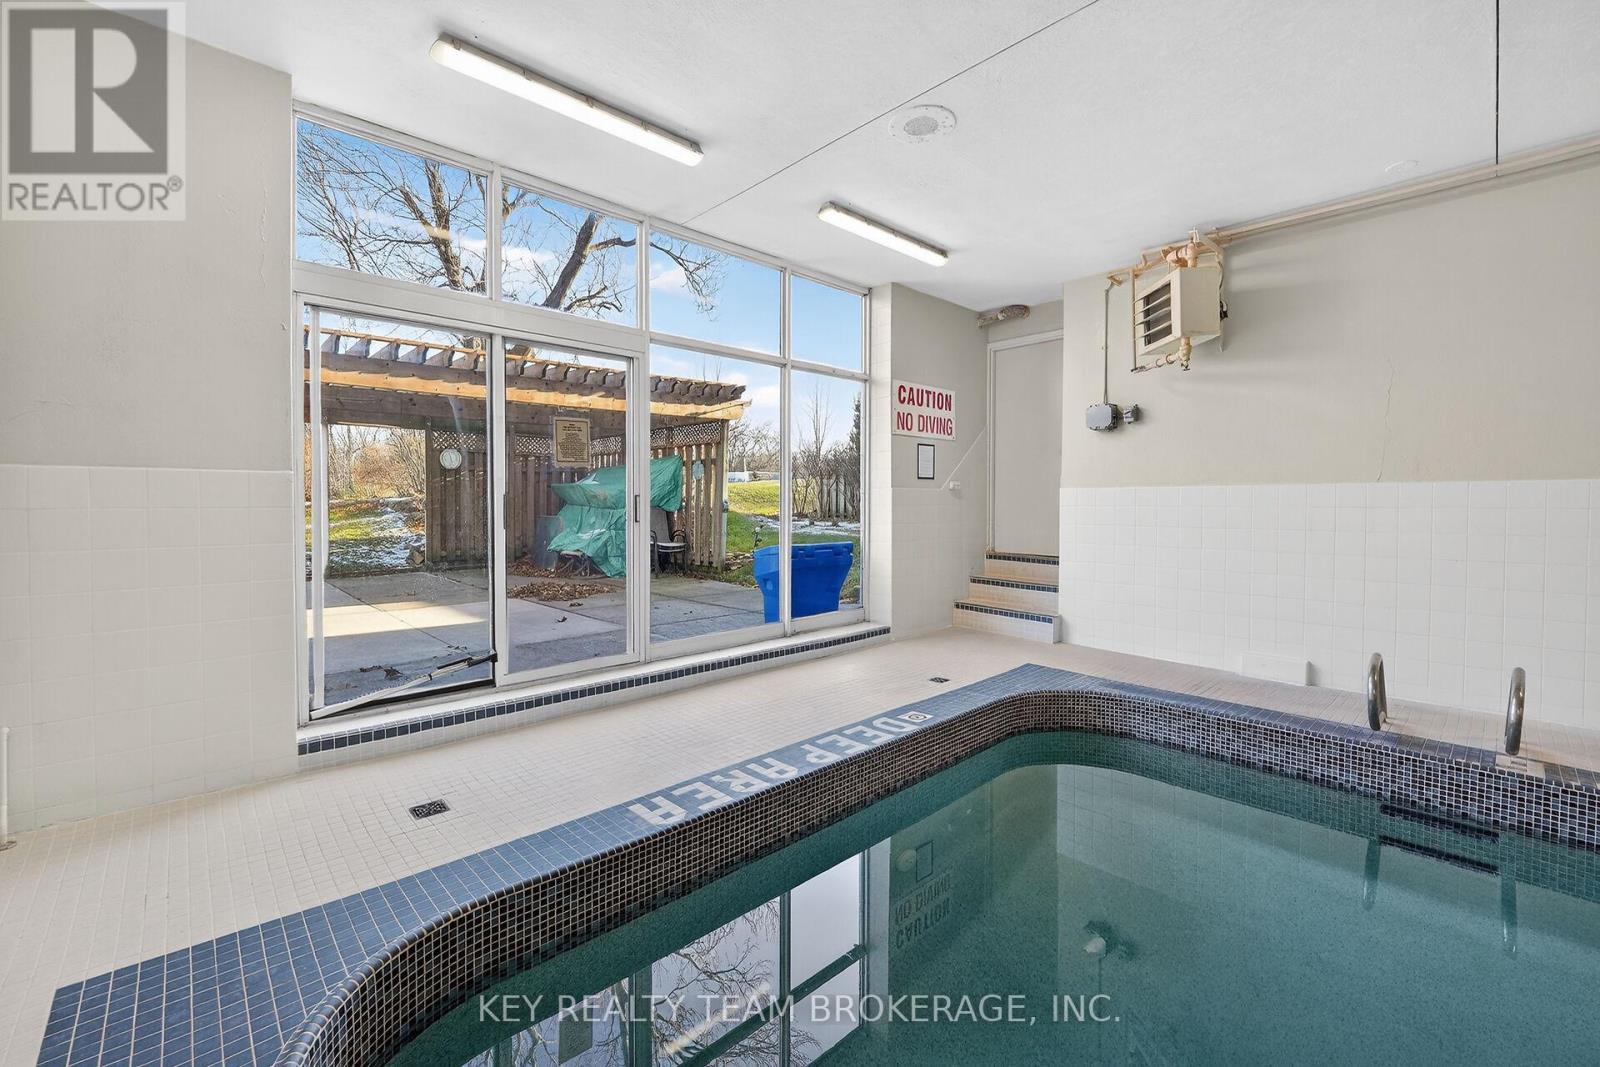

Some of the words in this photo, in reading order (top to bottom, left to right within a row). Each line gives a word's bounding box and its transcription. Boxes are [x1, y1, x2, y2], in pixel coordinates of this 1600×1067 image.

[897, 384, 952, 412] CAUTION
[896, 411, 913, 432] NO
[917, 414, 953, 436] DIVING
[800, 716, 909, 765] DEEP
[628, 757, 799, 826] AREA
